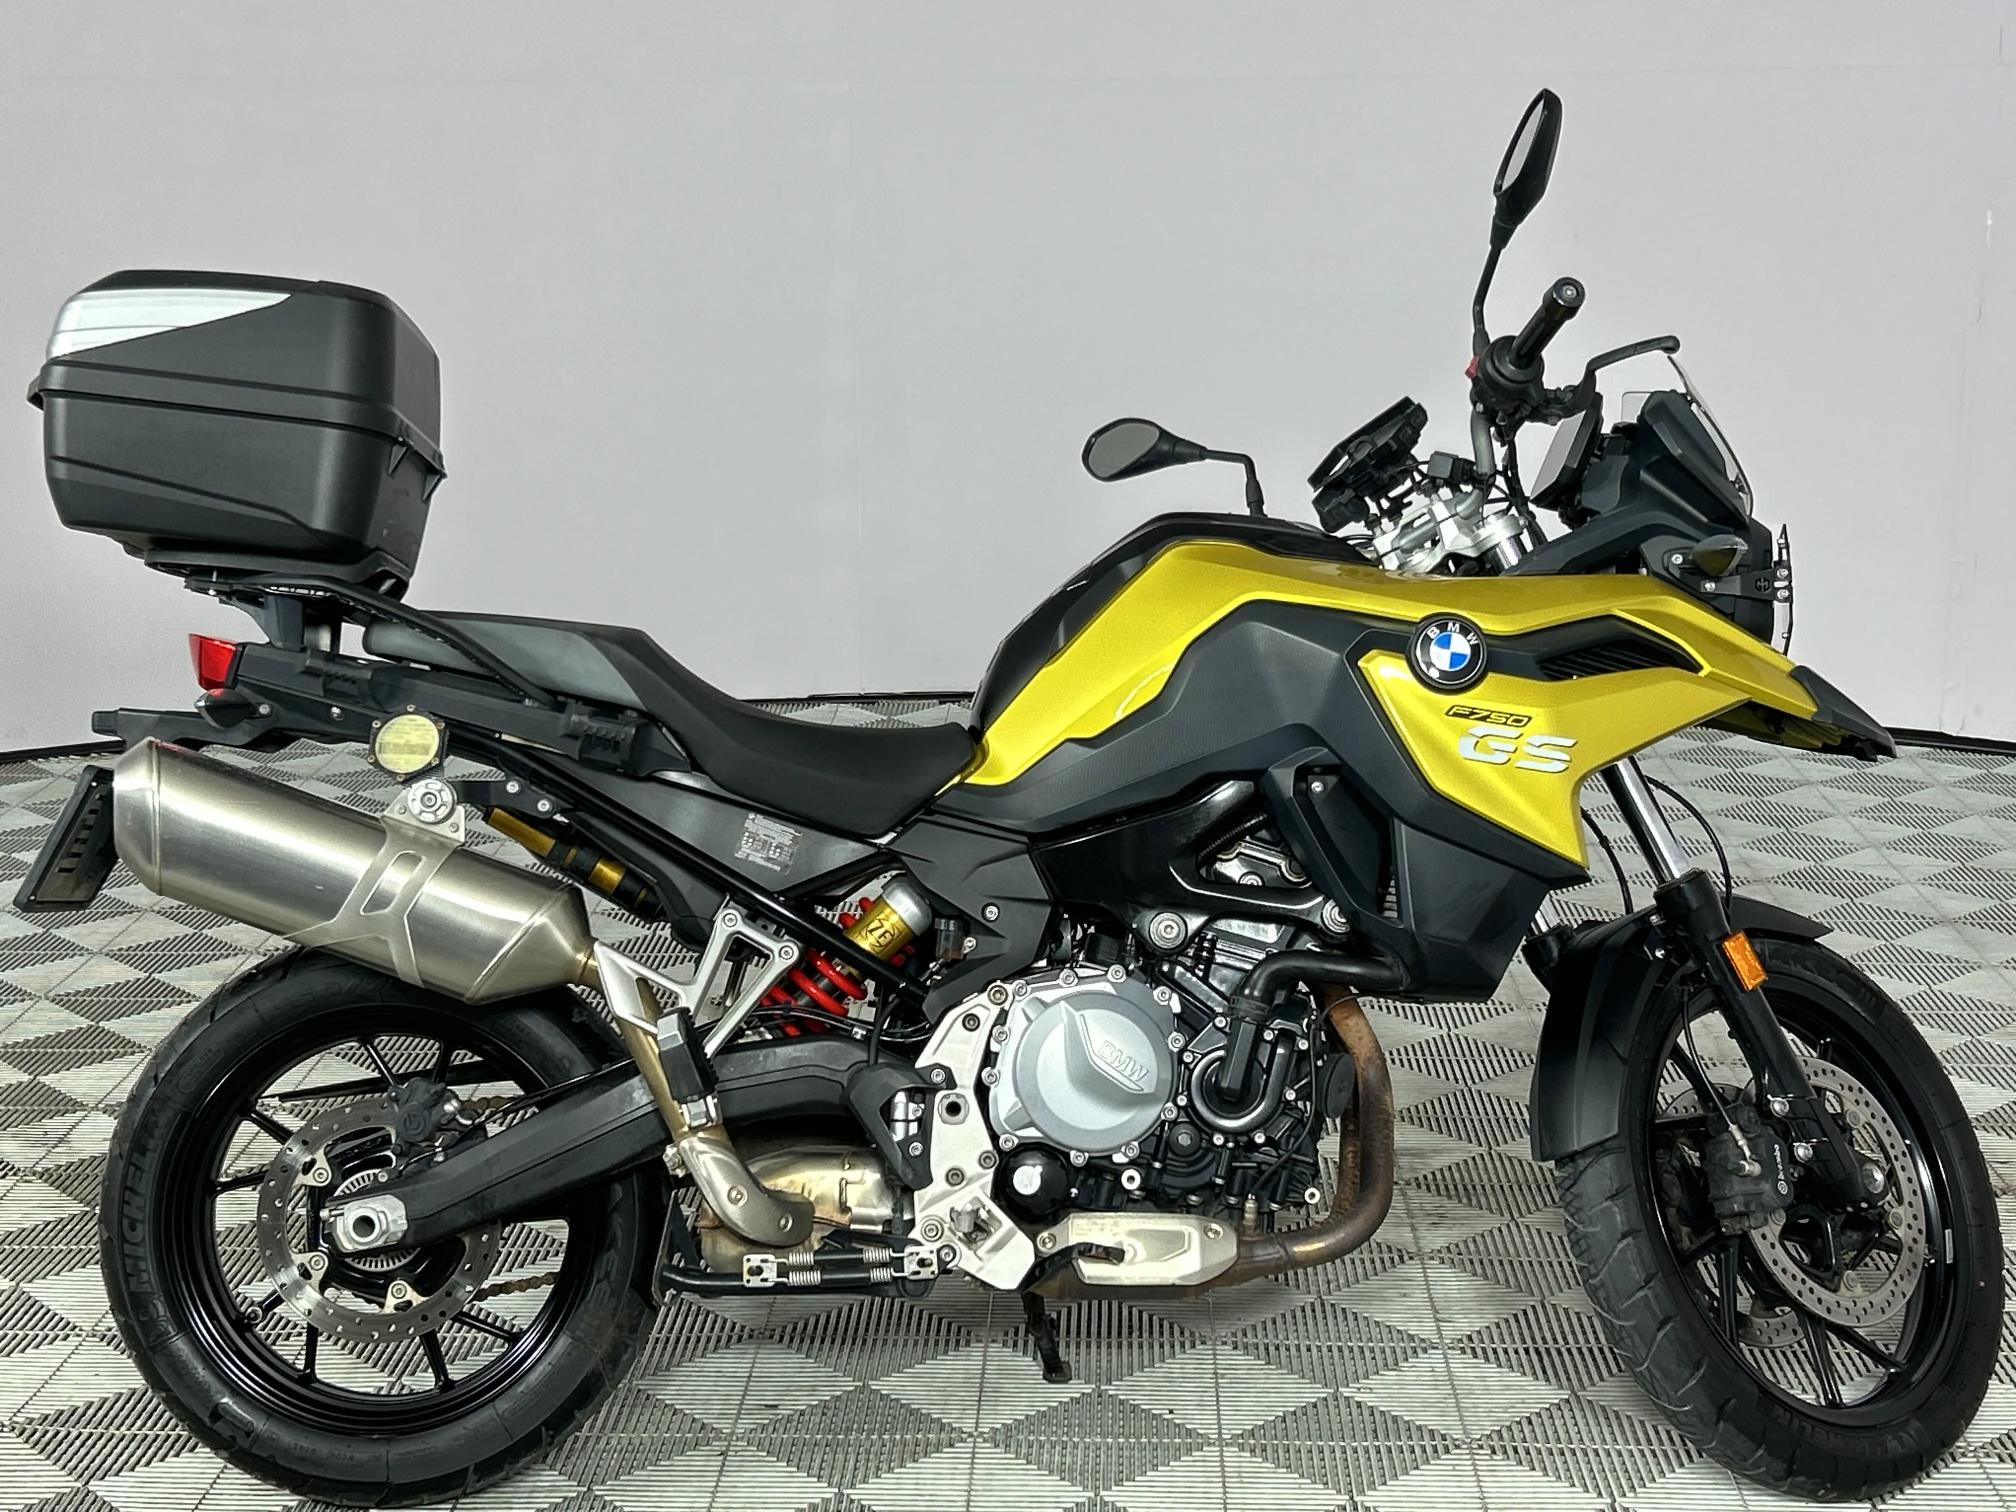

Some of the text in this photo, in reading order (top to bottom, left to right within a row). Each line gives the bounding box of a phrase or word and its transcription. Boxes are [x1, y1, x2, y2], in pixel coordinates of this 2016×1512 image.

[1425, 622, 1479, 646] BMW
[1446, 705, 1531, 727] F750
[1458, 727, 1577, 773] GS
[1097, 1039, 1149, 1082] BMW
